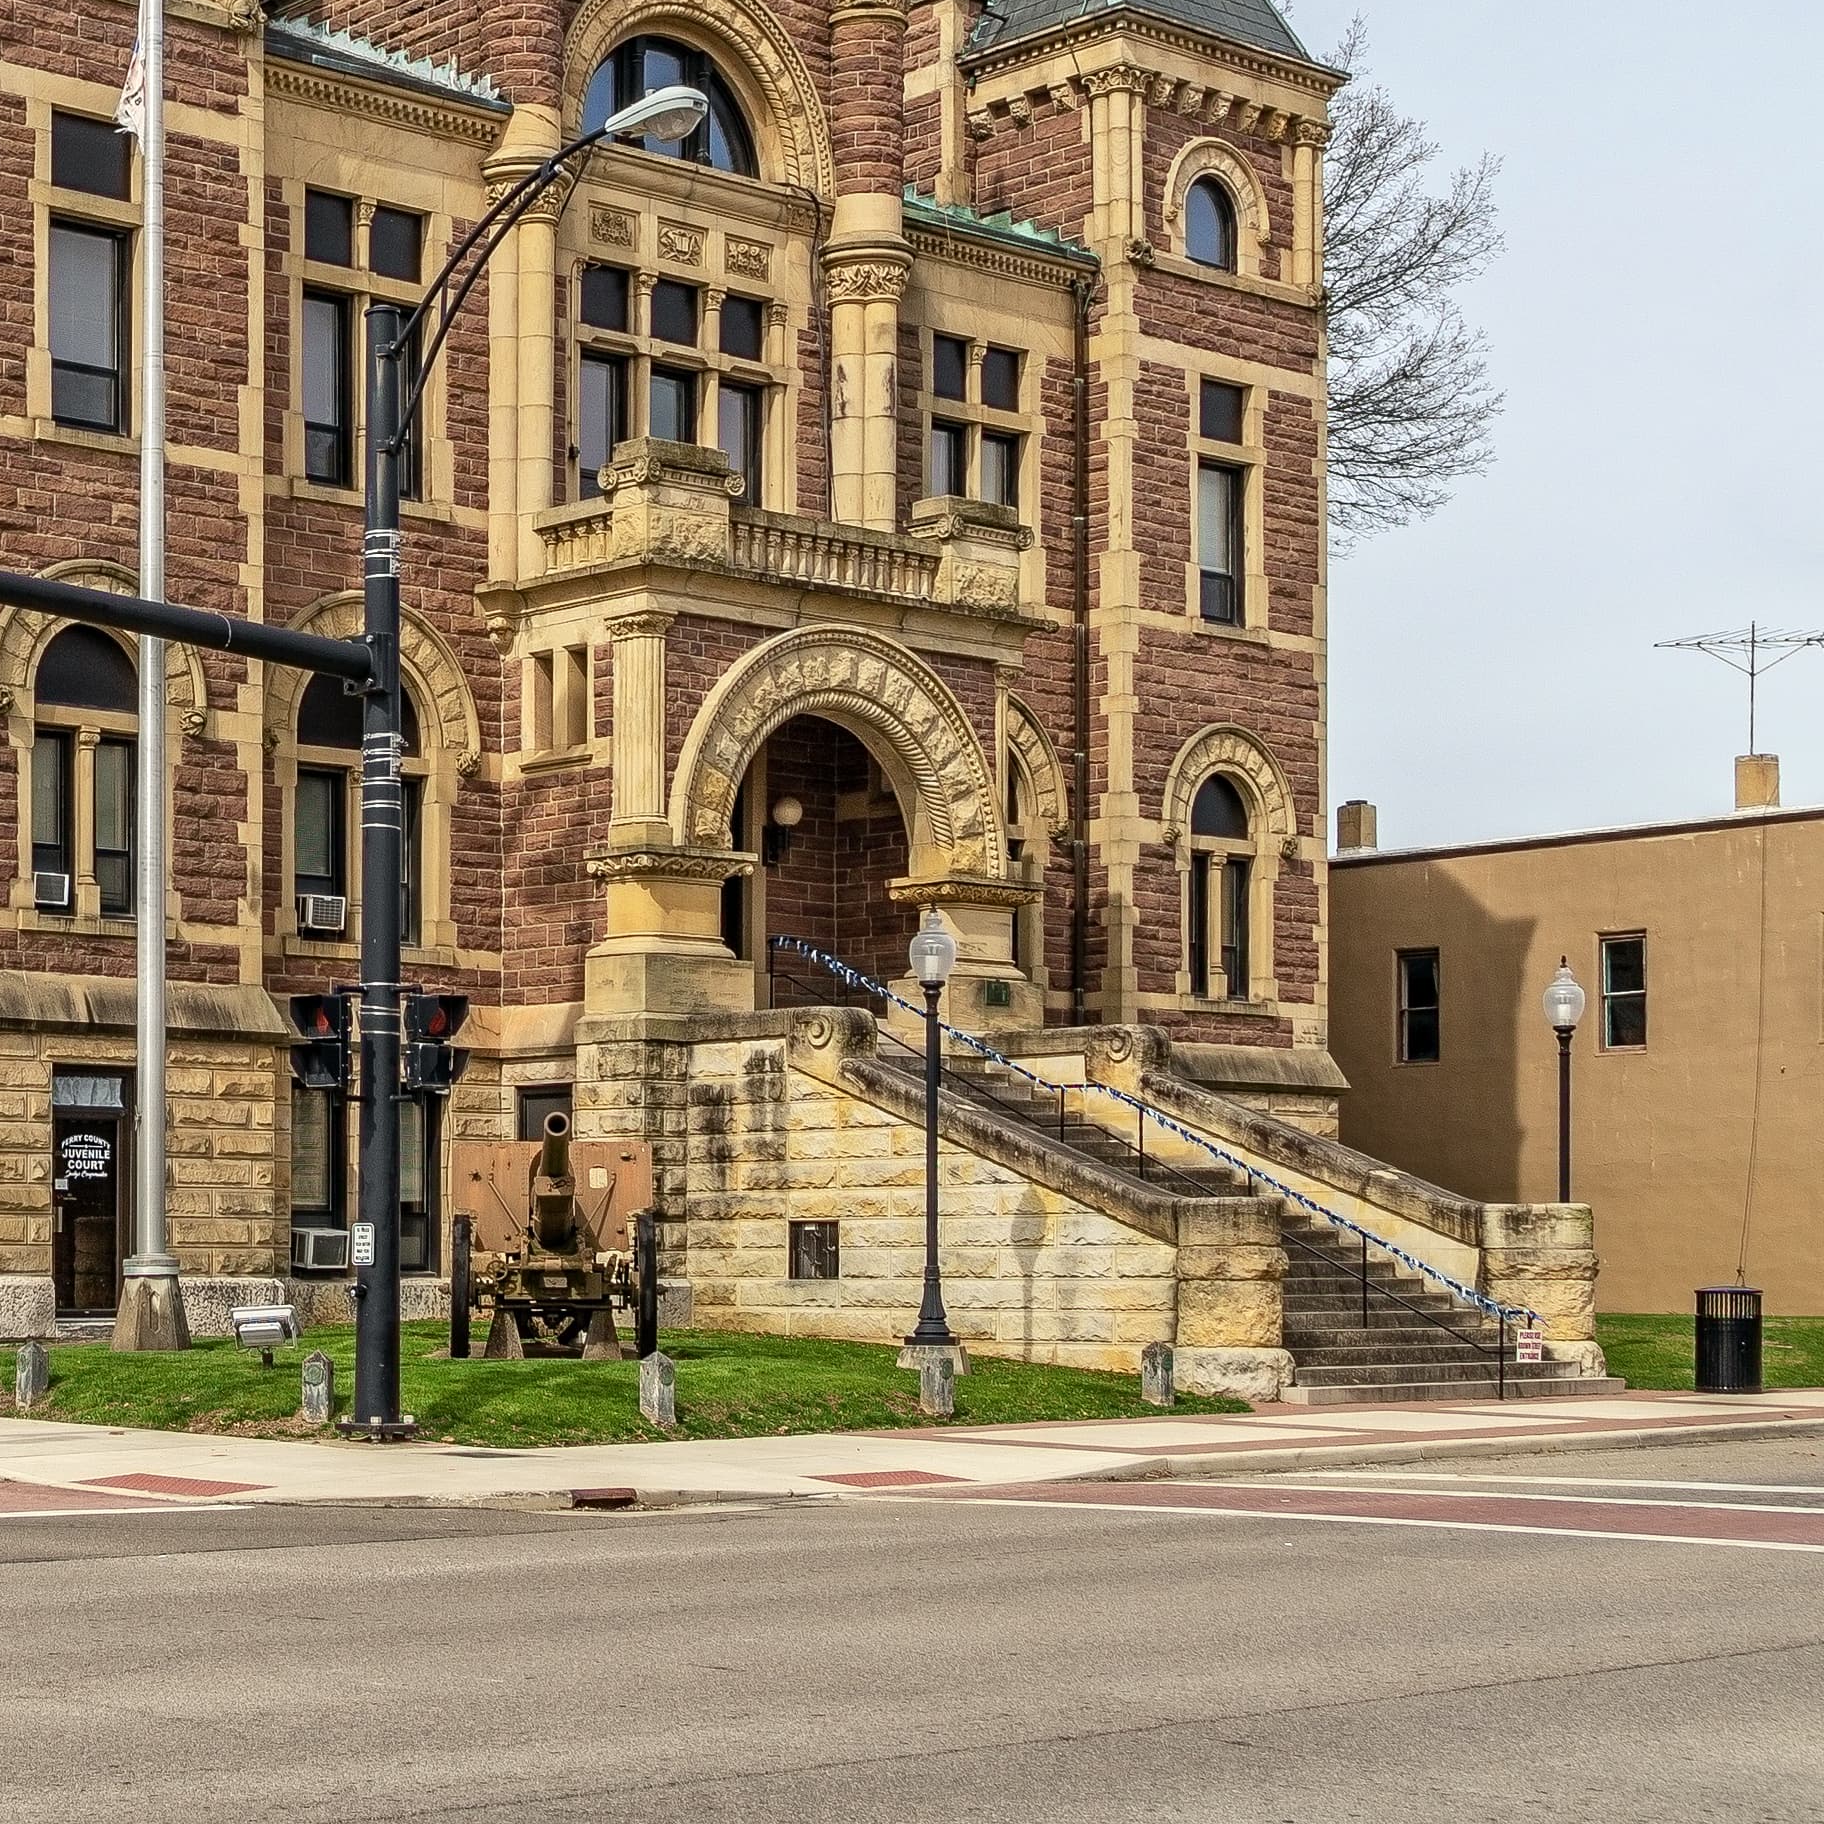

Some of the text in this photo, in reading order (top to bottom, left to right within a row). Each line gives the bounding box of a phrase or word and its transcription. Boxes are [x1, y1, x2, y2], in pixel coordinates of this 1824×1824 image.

[84, 1134, 111, 1149] COUNTY
[62, 1149, 111, 1159] JUVENILE
[68, 1159, 105, 1170] COURT
